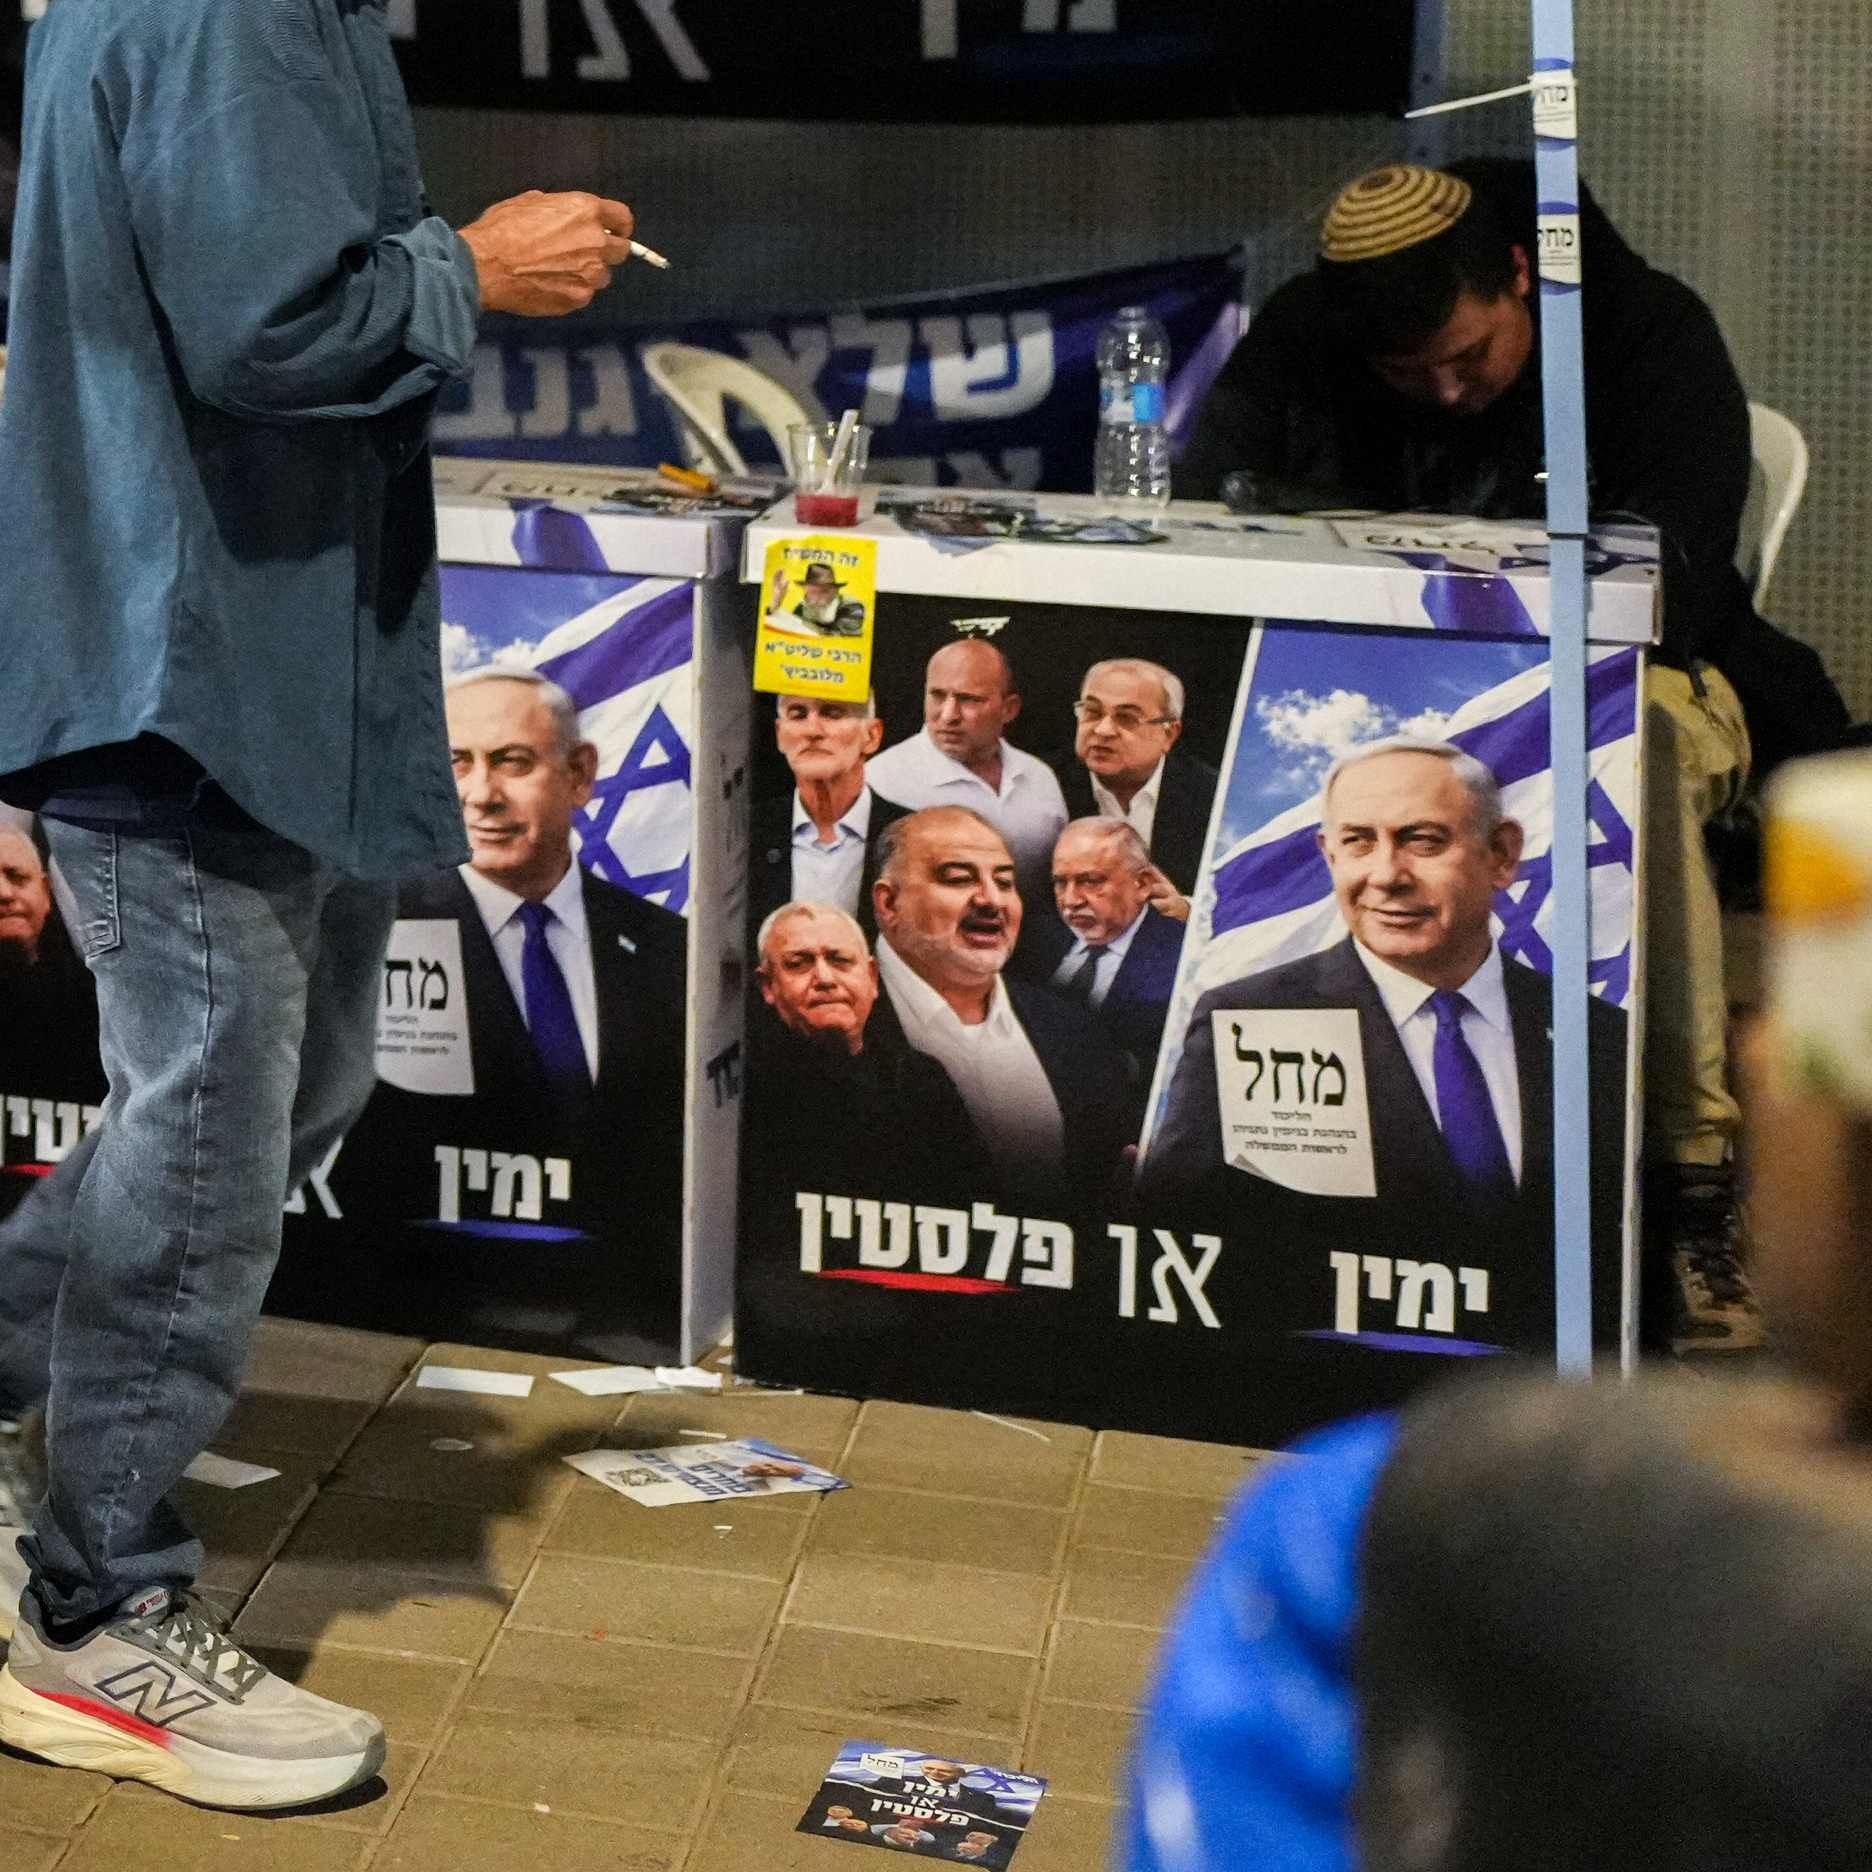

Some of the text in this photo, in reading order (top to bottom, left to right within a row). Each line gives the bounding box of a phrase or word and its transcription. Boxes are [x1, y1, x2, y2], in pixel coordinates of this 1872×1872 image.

[385, 956, 449, 1011] מח
[1231, 1021, 1348, 1107] מחל
[434, 1143, 572, 1223] ימין
[795, 1189, 1490, 1335] ימין או פלסטין
